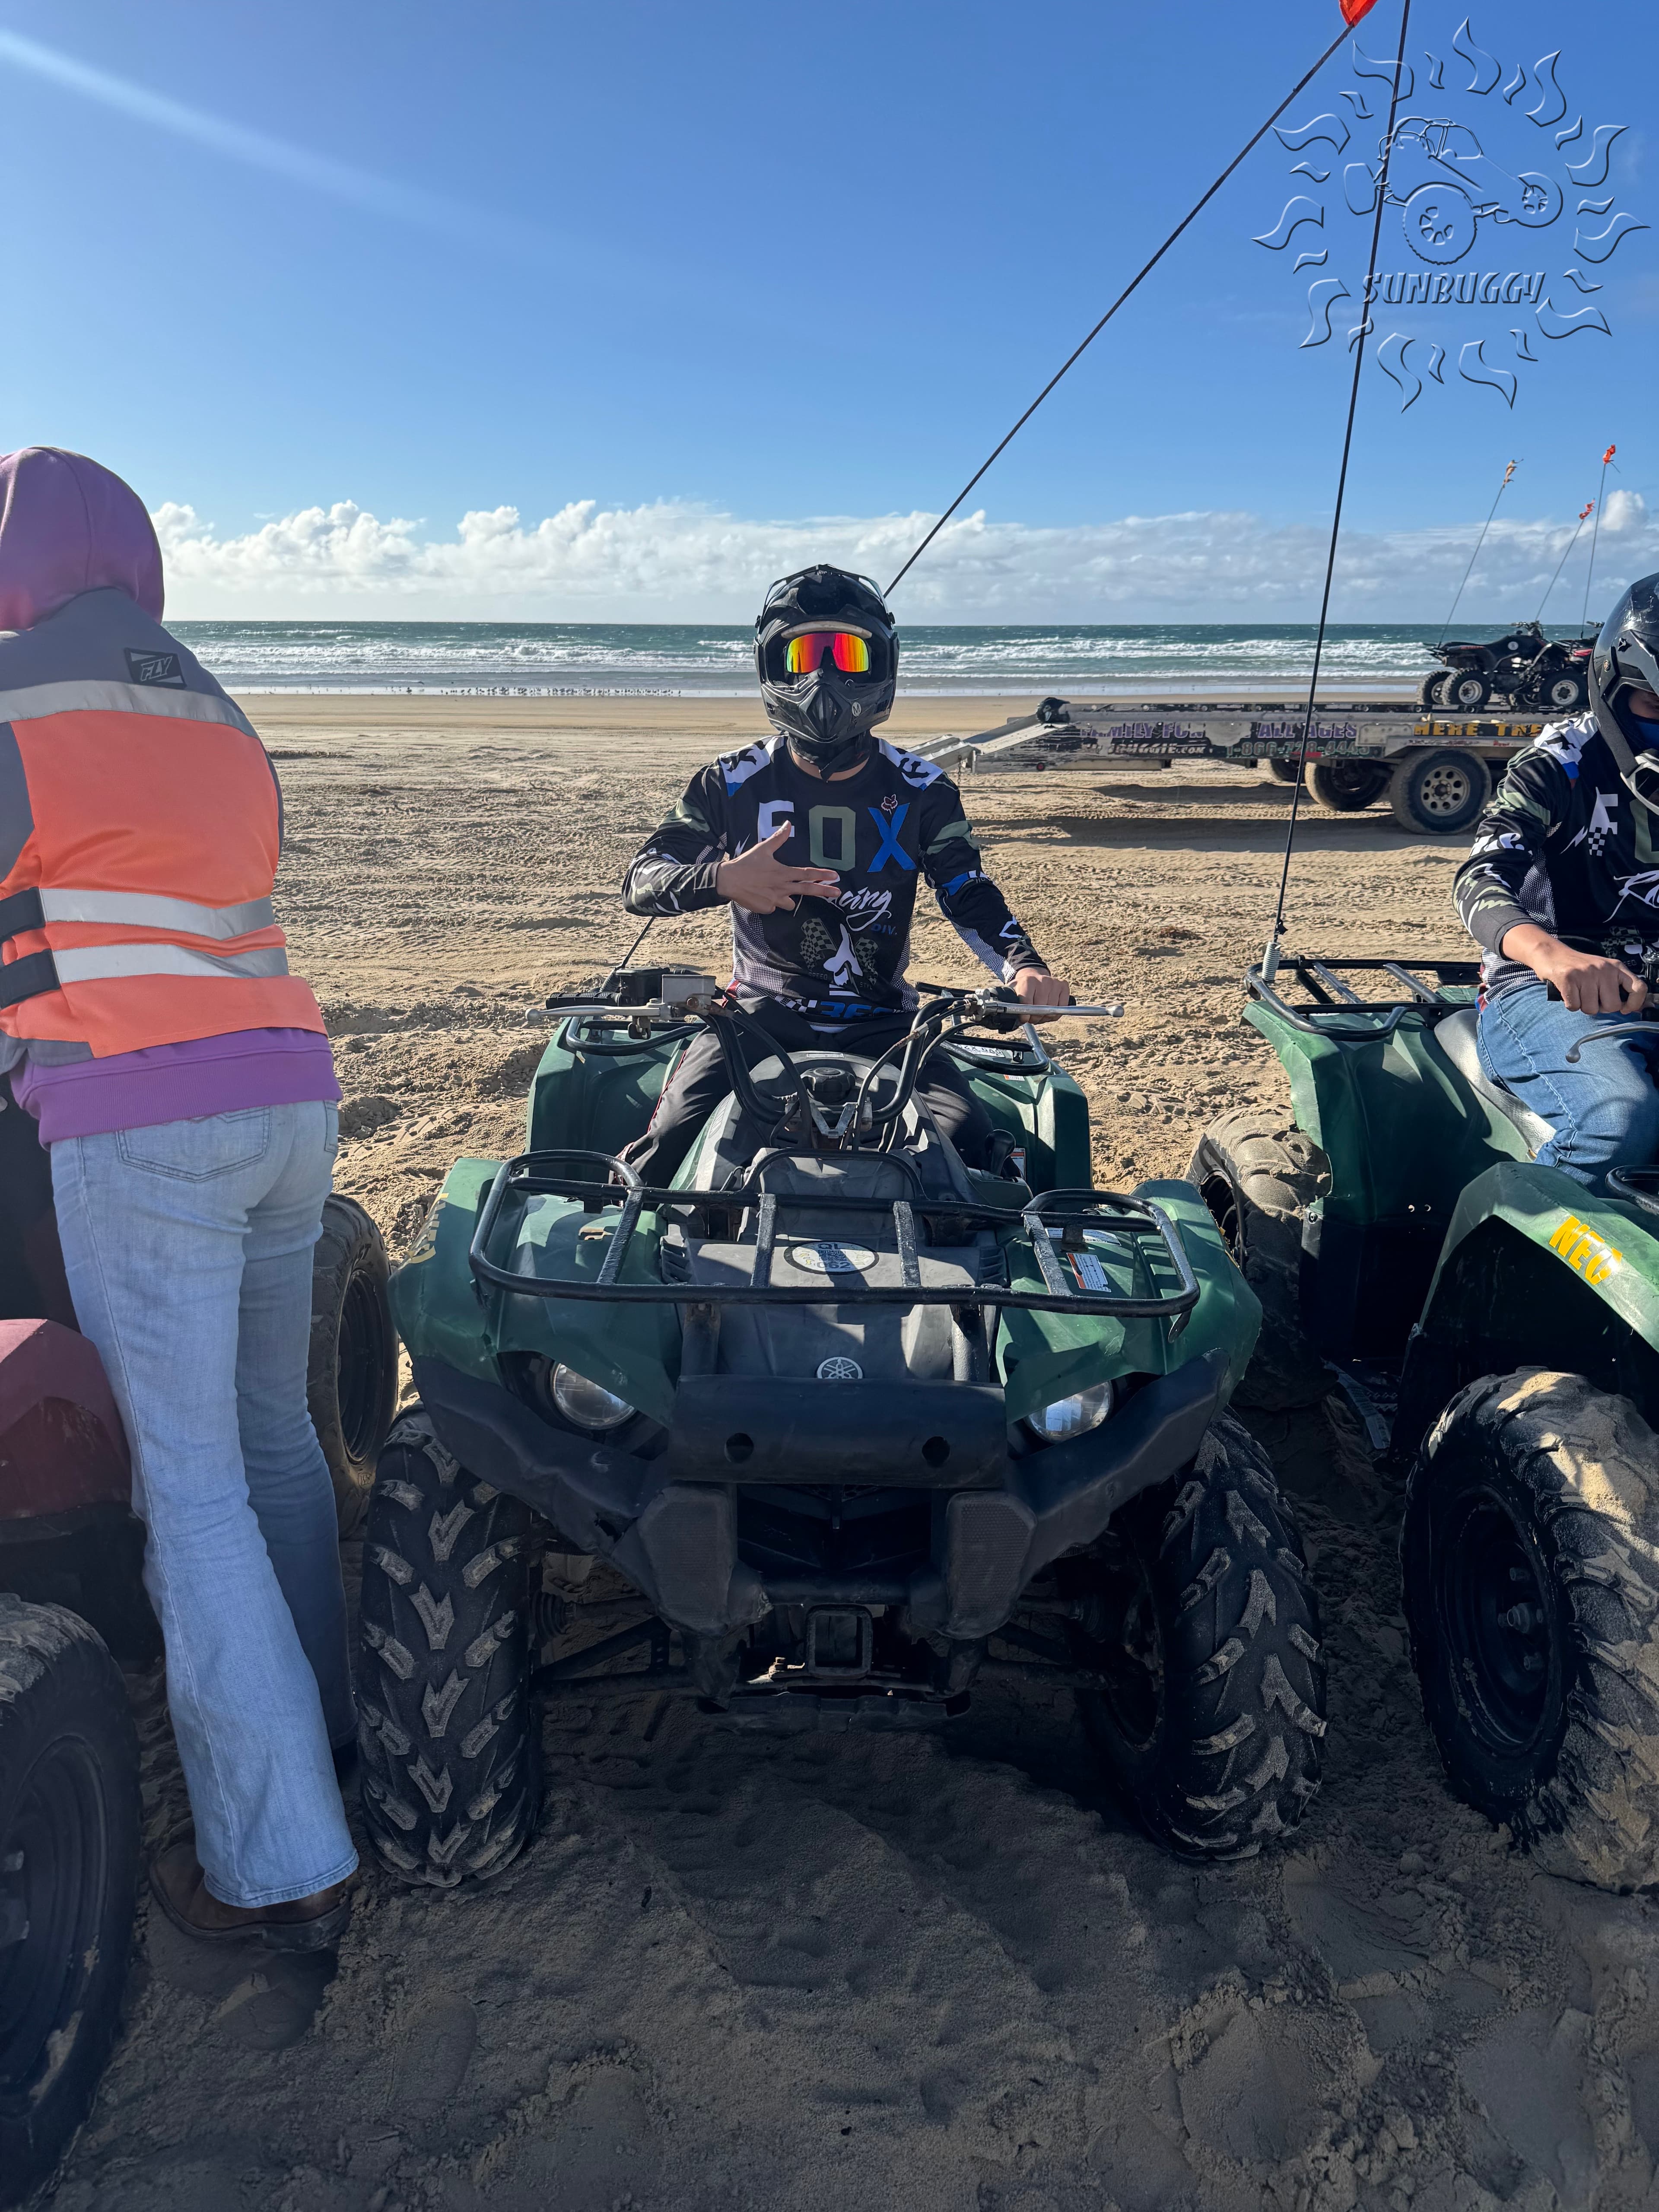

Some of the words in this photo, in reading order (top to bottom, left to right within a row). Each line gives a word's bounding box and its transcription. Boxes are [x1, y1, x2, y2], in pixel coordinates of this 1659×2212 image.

[140, 656, 173, 681] FLY
[1258, 724, 1295, 738] ALL
[1304, 724, 1357, 738] AGES
[758, 799, 917, 873] FOX
[870, 923, 897, 935] DIV.
